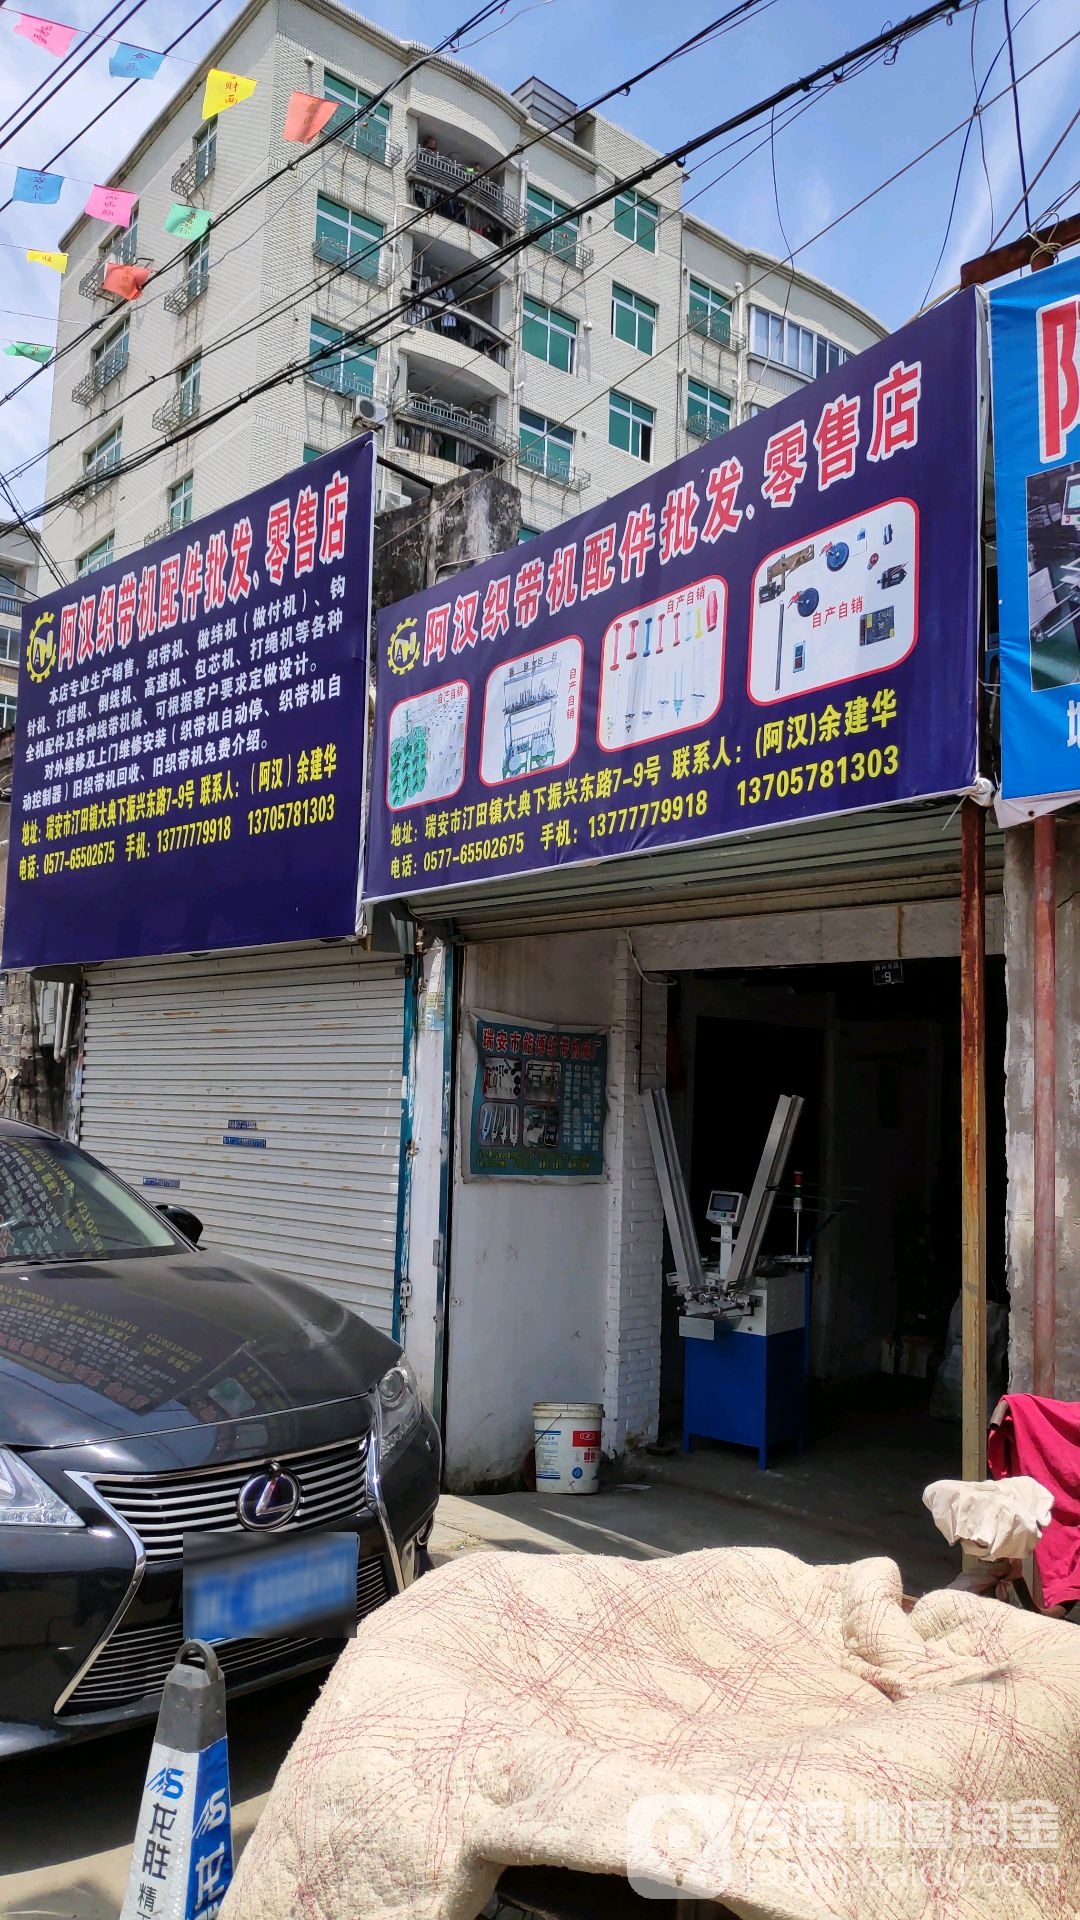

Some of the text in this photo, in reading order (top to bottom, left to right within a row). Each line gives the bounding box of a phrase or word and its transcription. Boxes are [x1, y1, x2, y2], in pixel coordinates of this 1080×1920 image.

[666, 584, 706, 614] 自产自销
[812, 595, 864, 629] 自产自销
[437, 685, 464, 705] 自产自销
[566, 667, 577, 720] 自产自销
[736, 743, 899, 808] 13705781303
[247, 793, 335, 837] 13705781303
